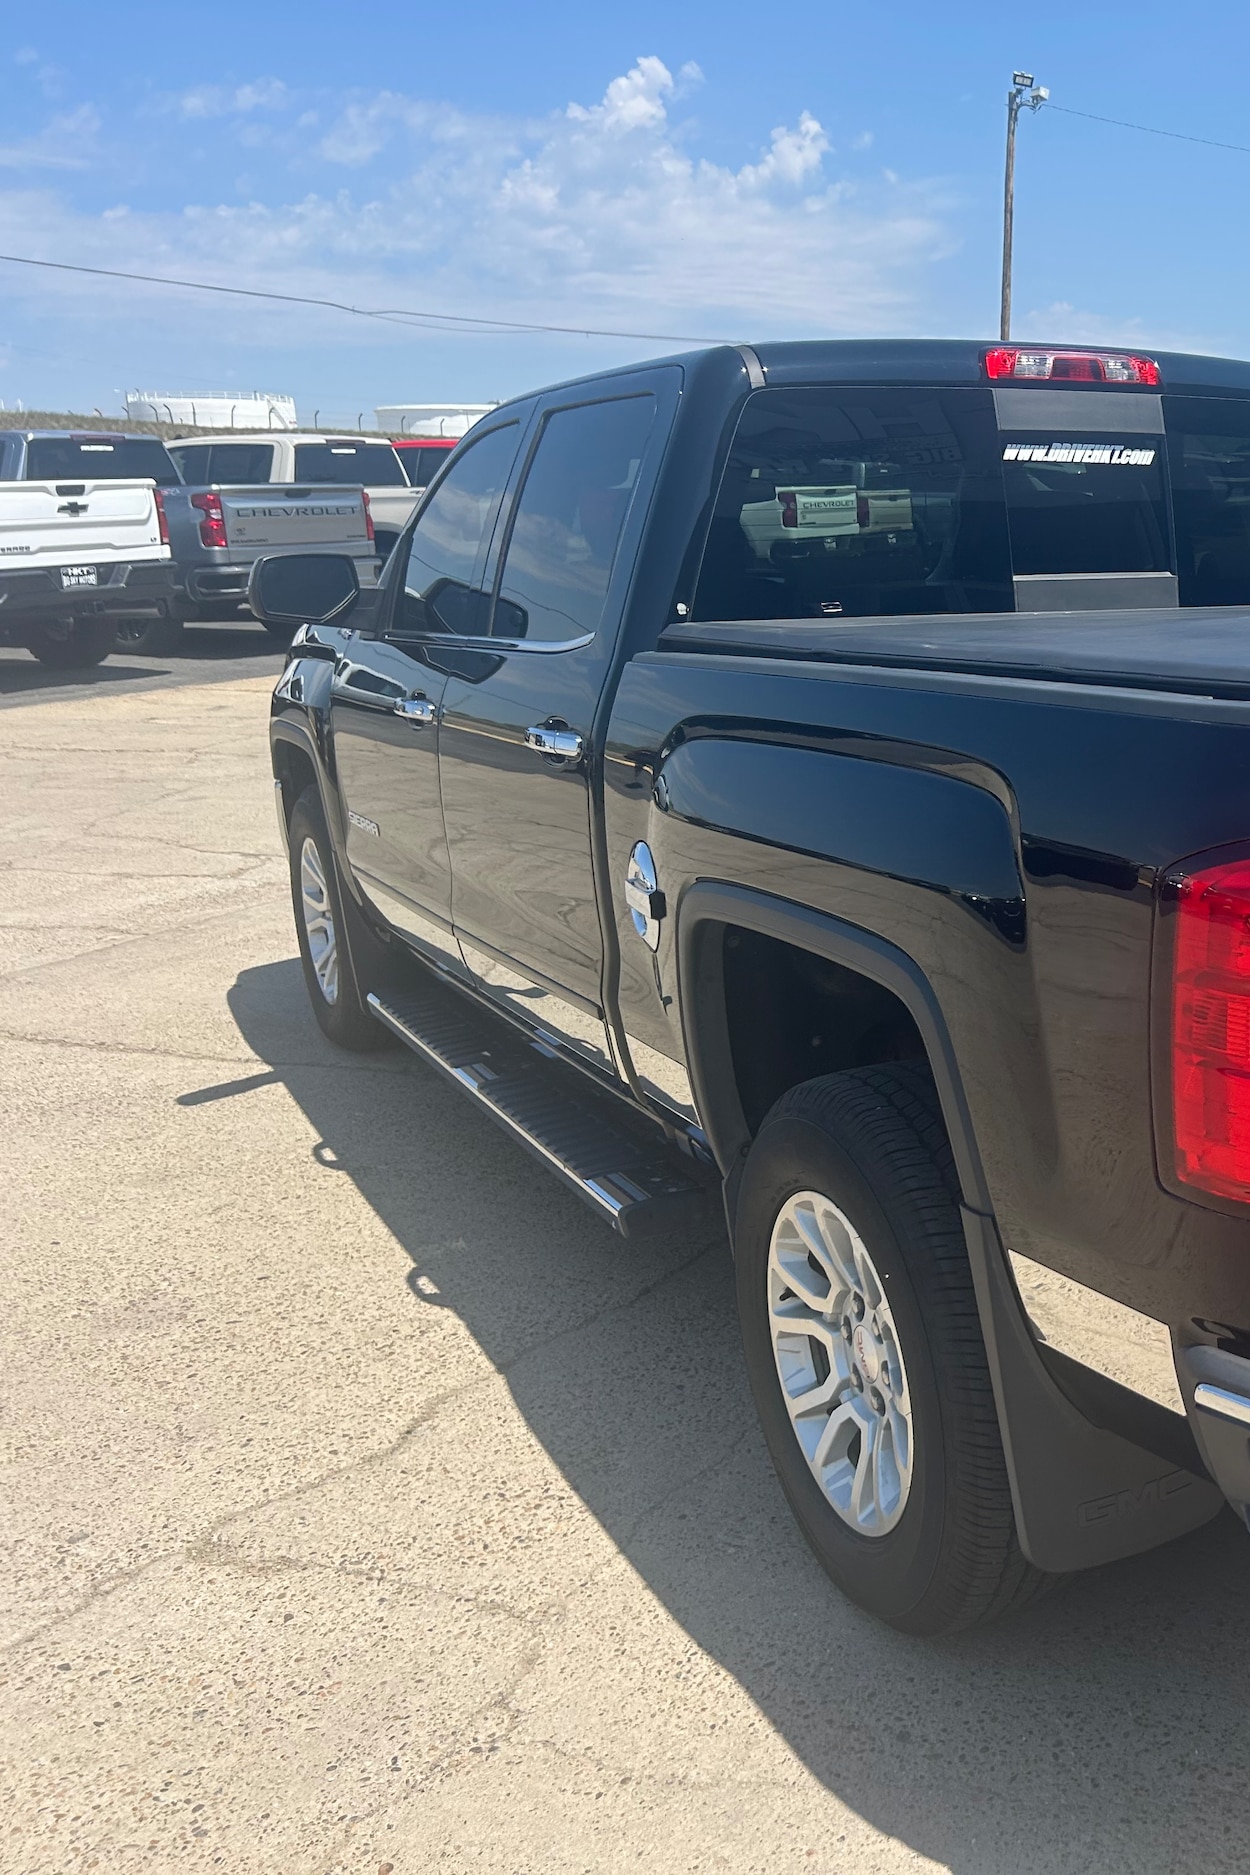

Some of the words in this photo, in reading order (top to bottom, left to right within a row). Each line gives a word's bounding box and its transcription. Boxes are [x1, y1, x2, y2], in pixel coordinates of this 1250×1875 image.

[237, 506, 357, 518] CHEVROLET
[803, 499, 855, 508] CHEVROLET
[348, 811, 380, 837] SIERRA
[1076, 1467, 1193, 1528] GMC
